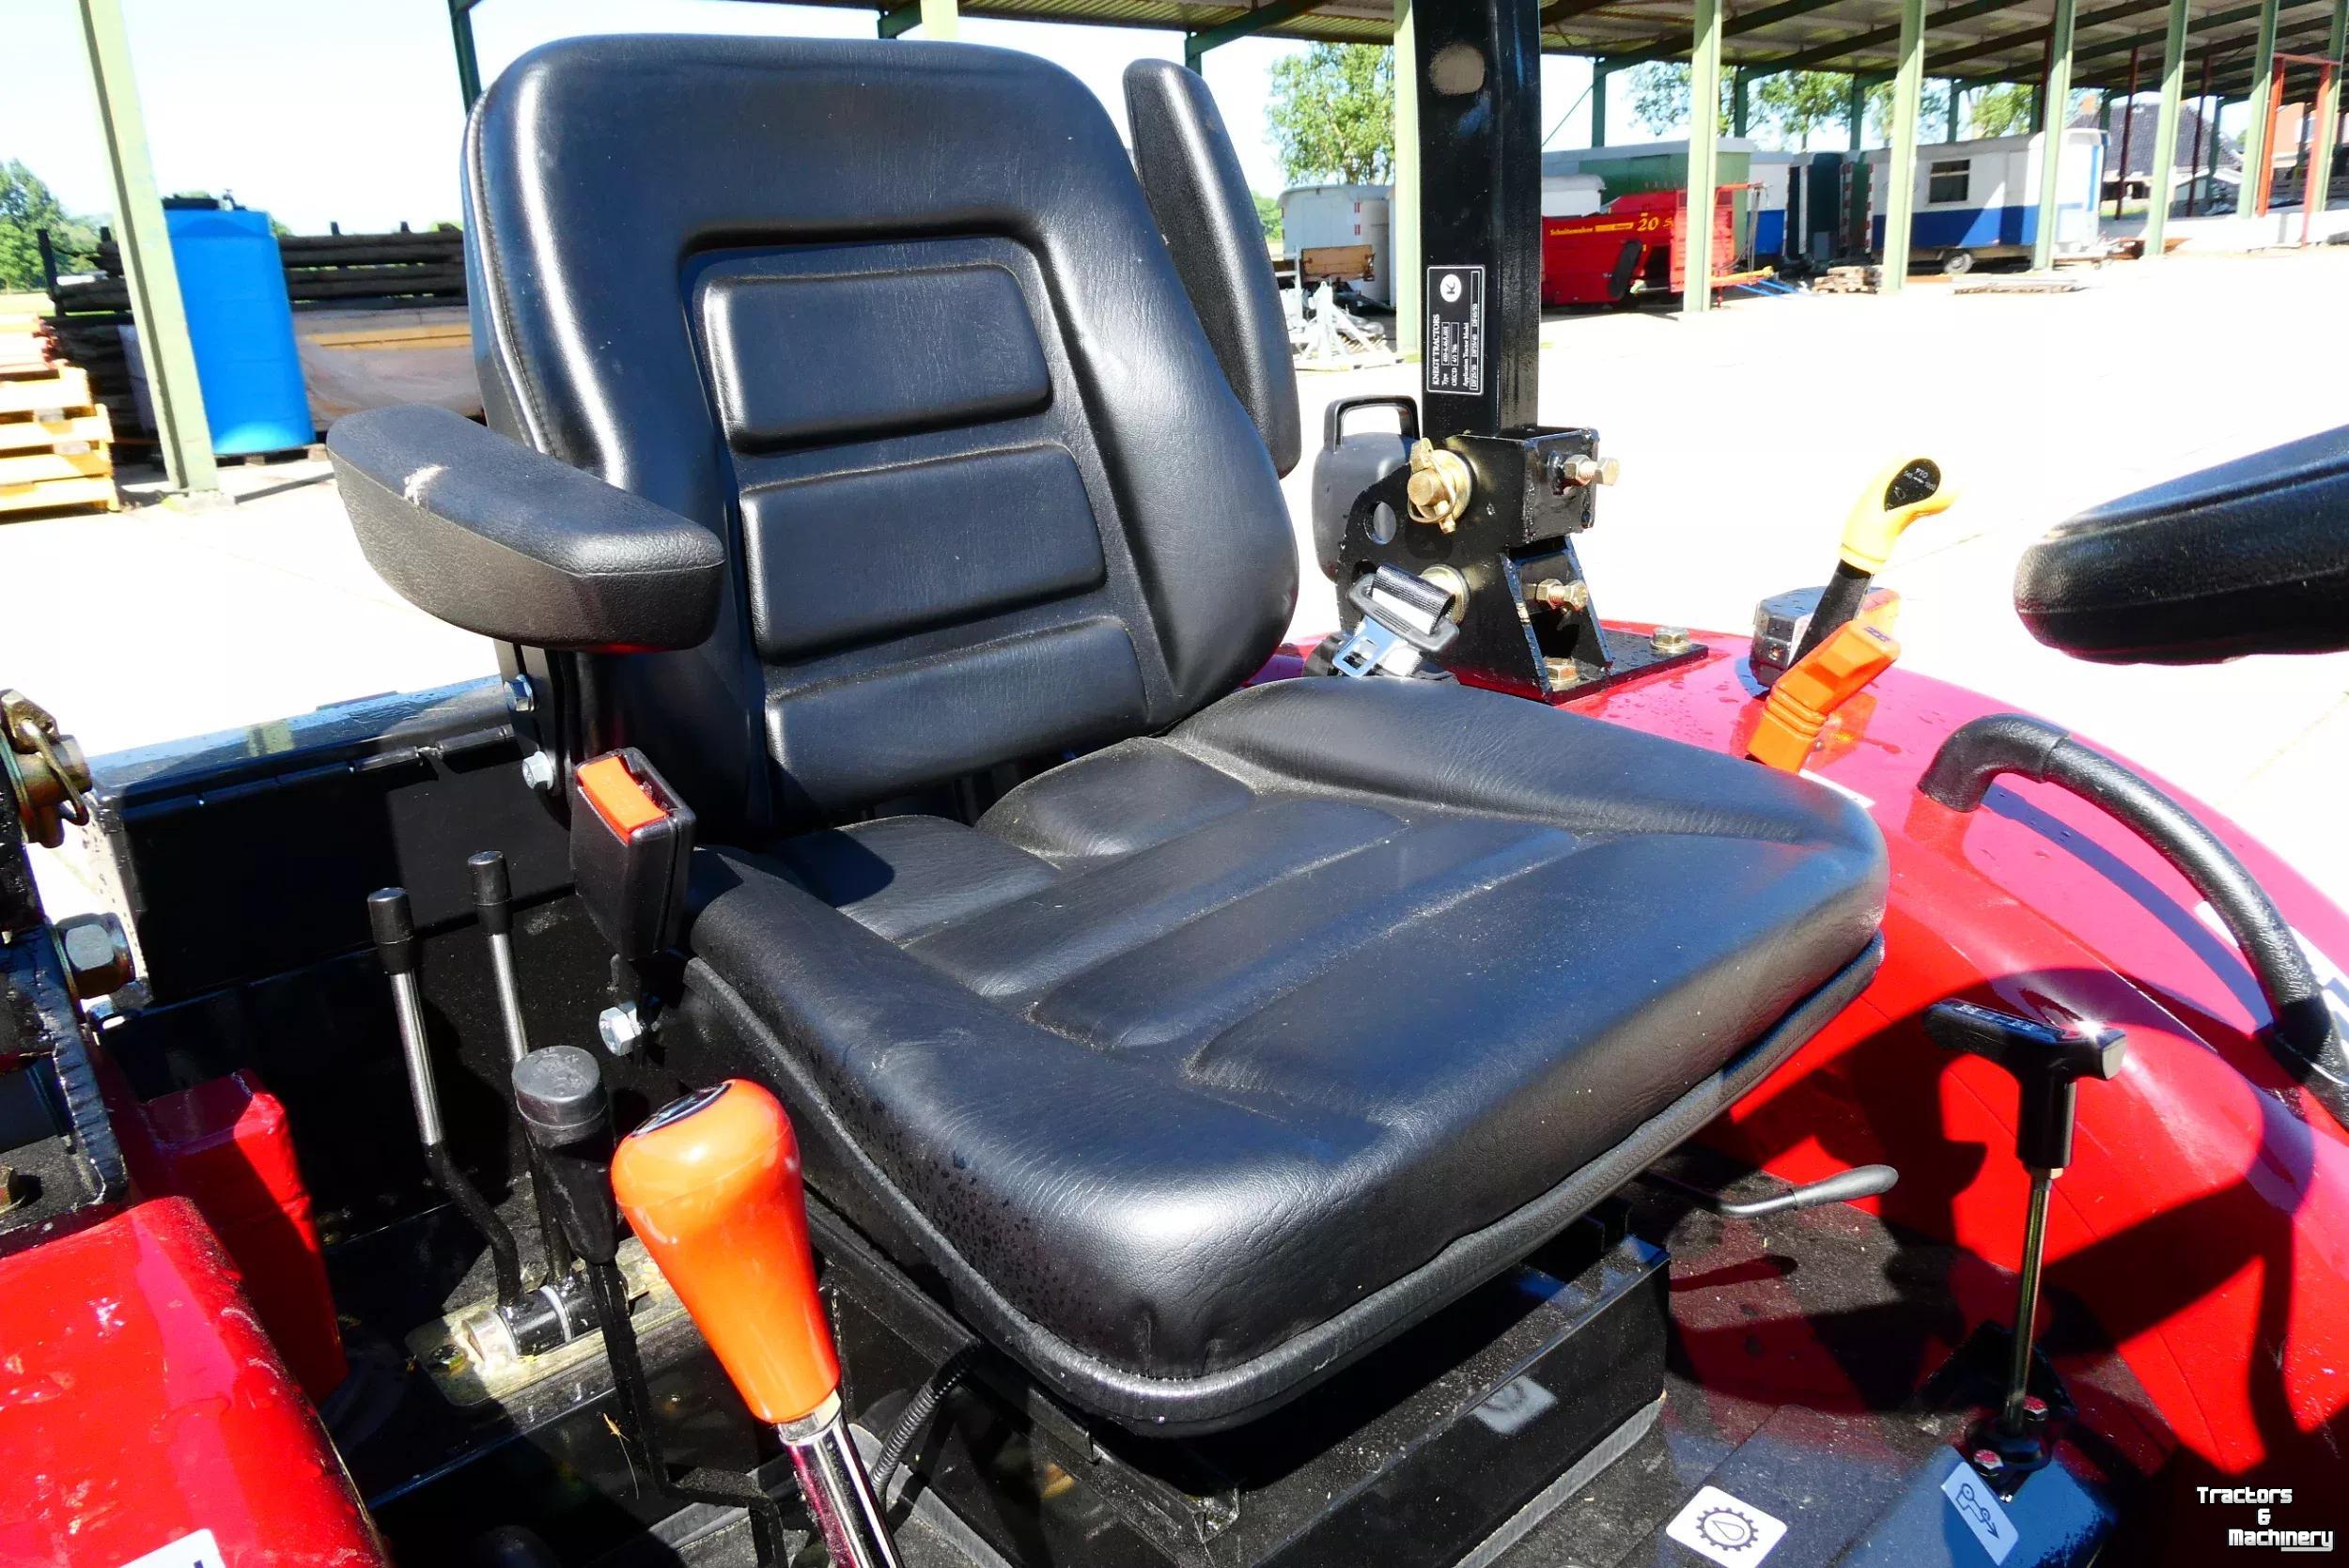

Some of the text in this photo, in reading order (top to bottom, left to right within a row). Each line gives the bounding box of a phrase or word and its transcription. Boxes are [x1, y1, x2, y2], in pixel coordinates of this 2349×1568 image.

[1637, 216, 1660, 232] 20
[1446, 282, 1455, 295] K
[1432, 313, 1440, 385] KNEGT TRACTORS
[1915, 468, 1928, 479] PTO
